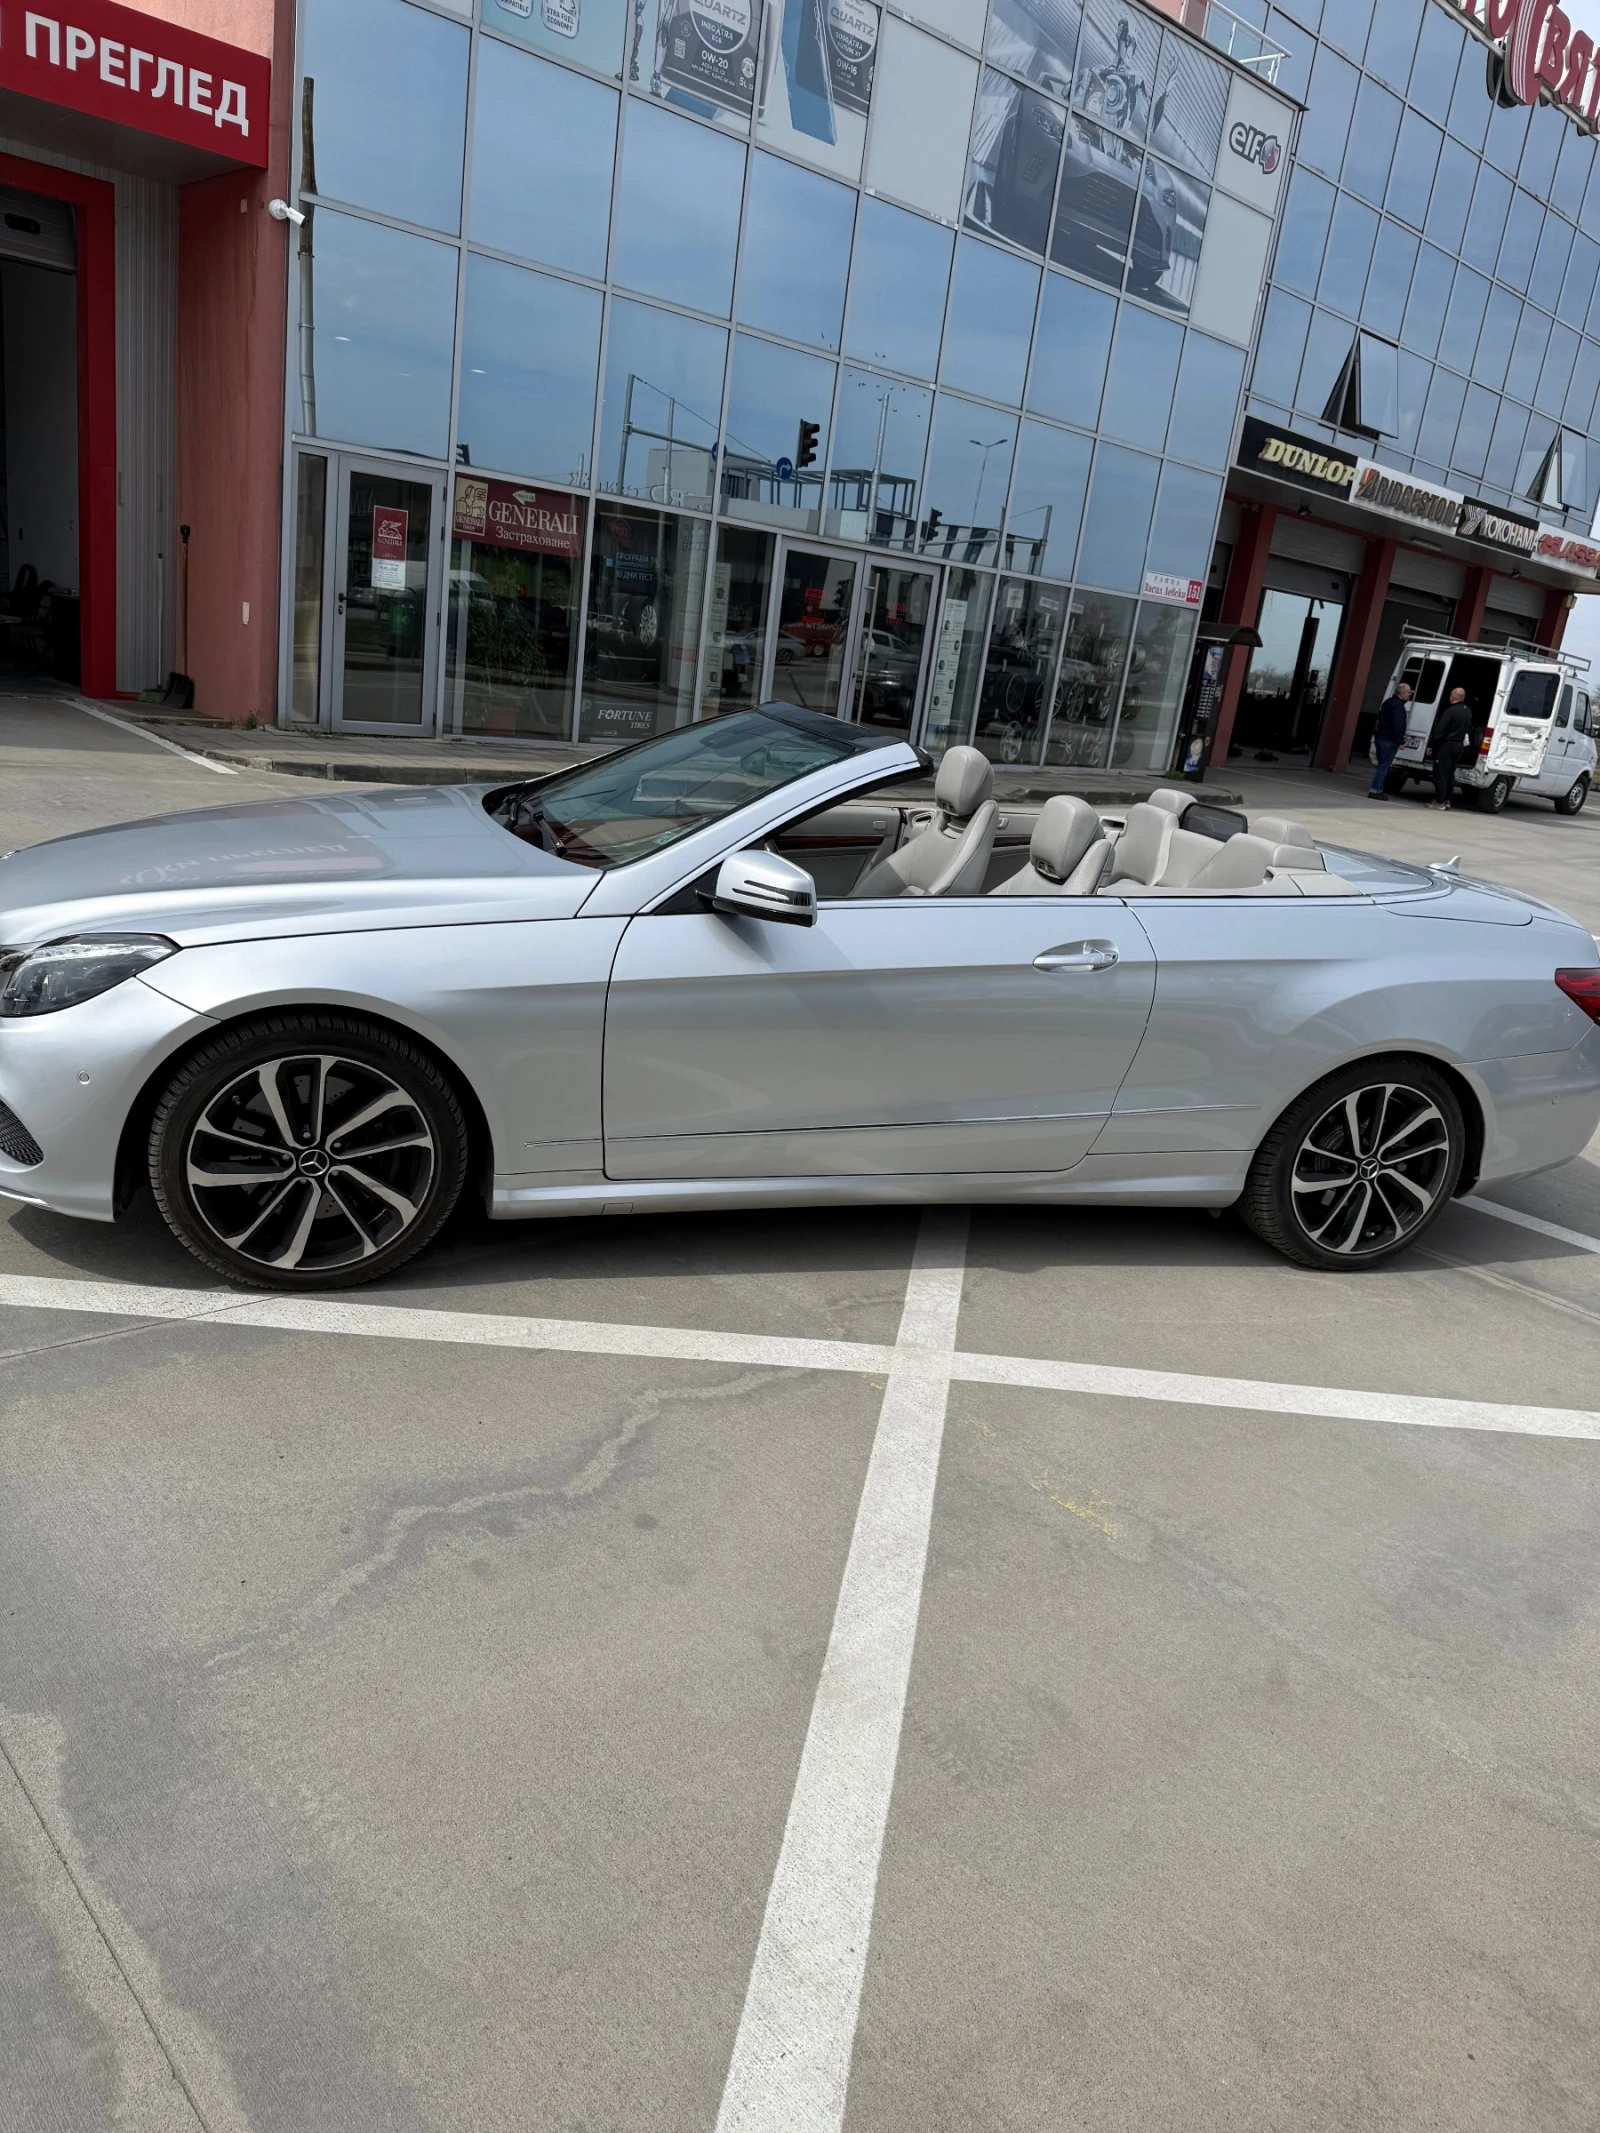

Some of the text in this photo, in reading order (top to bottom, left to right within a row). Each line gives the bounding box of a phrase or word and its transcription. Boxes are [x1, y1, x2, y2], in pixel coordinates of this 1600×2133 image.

[546, 6, 574, 24] XTRA FUEL
[547, 15, 573, 32] ECONOMY
[830, 6, 876, 38] QUARTZ
[701, 50, 729, 69] 0W-20
[836, 58, 858, 76] 0W-16
[25, 11, 249, 137] ПРЕГЛЕД
[1230, 123, 1265, 162] elf
[1260, 438, 1359, 486] DUNLOP
[1356, 468, 1464, 527] BRIDGESTONE
[456, 515, 484, 527] GENERALI
[488, 501, 579, 535] GENERALI
[496, 526, 570, 549] Застраховане
[1483, 514, 1539, 551] YOKOHAMA
[378, 538, 402, 546] GENERALI
[616, 551, 649, 563] ПРОГРАМА
[623, 570, 637, 580] ДНИ
[638, 573, 653, 581] ТЕСТ
[1187, 584, 1201, 600] 151
[597, 709, 653, 722] FORTUNE
